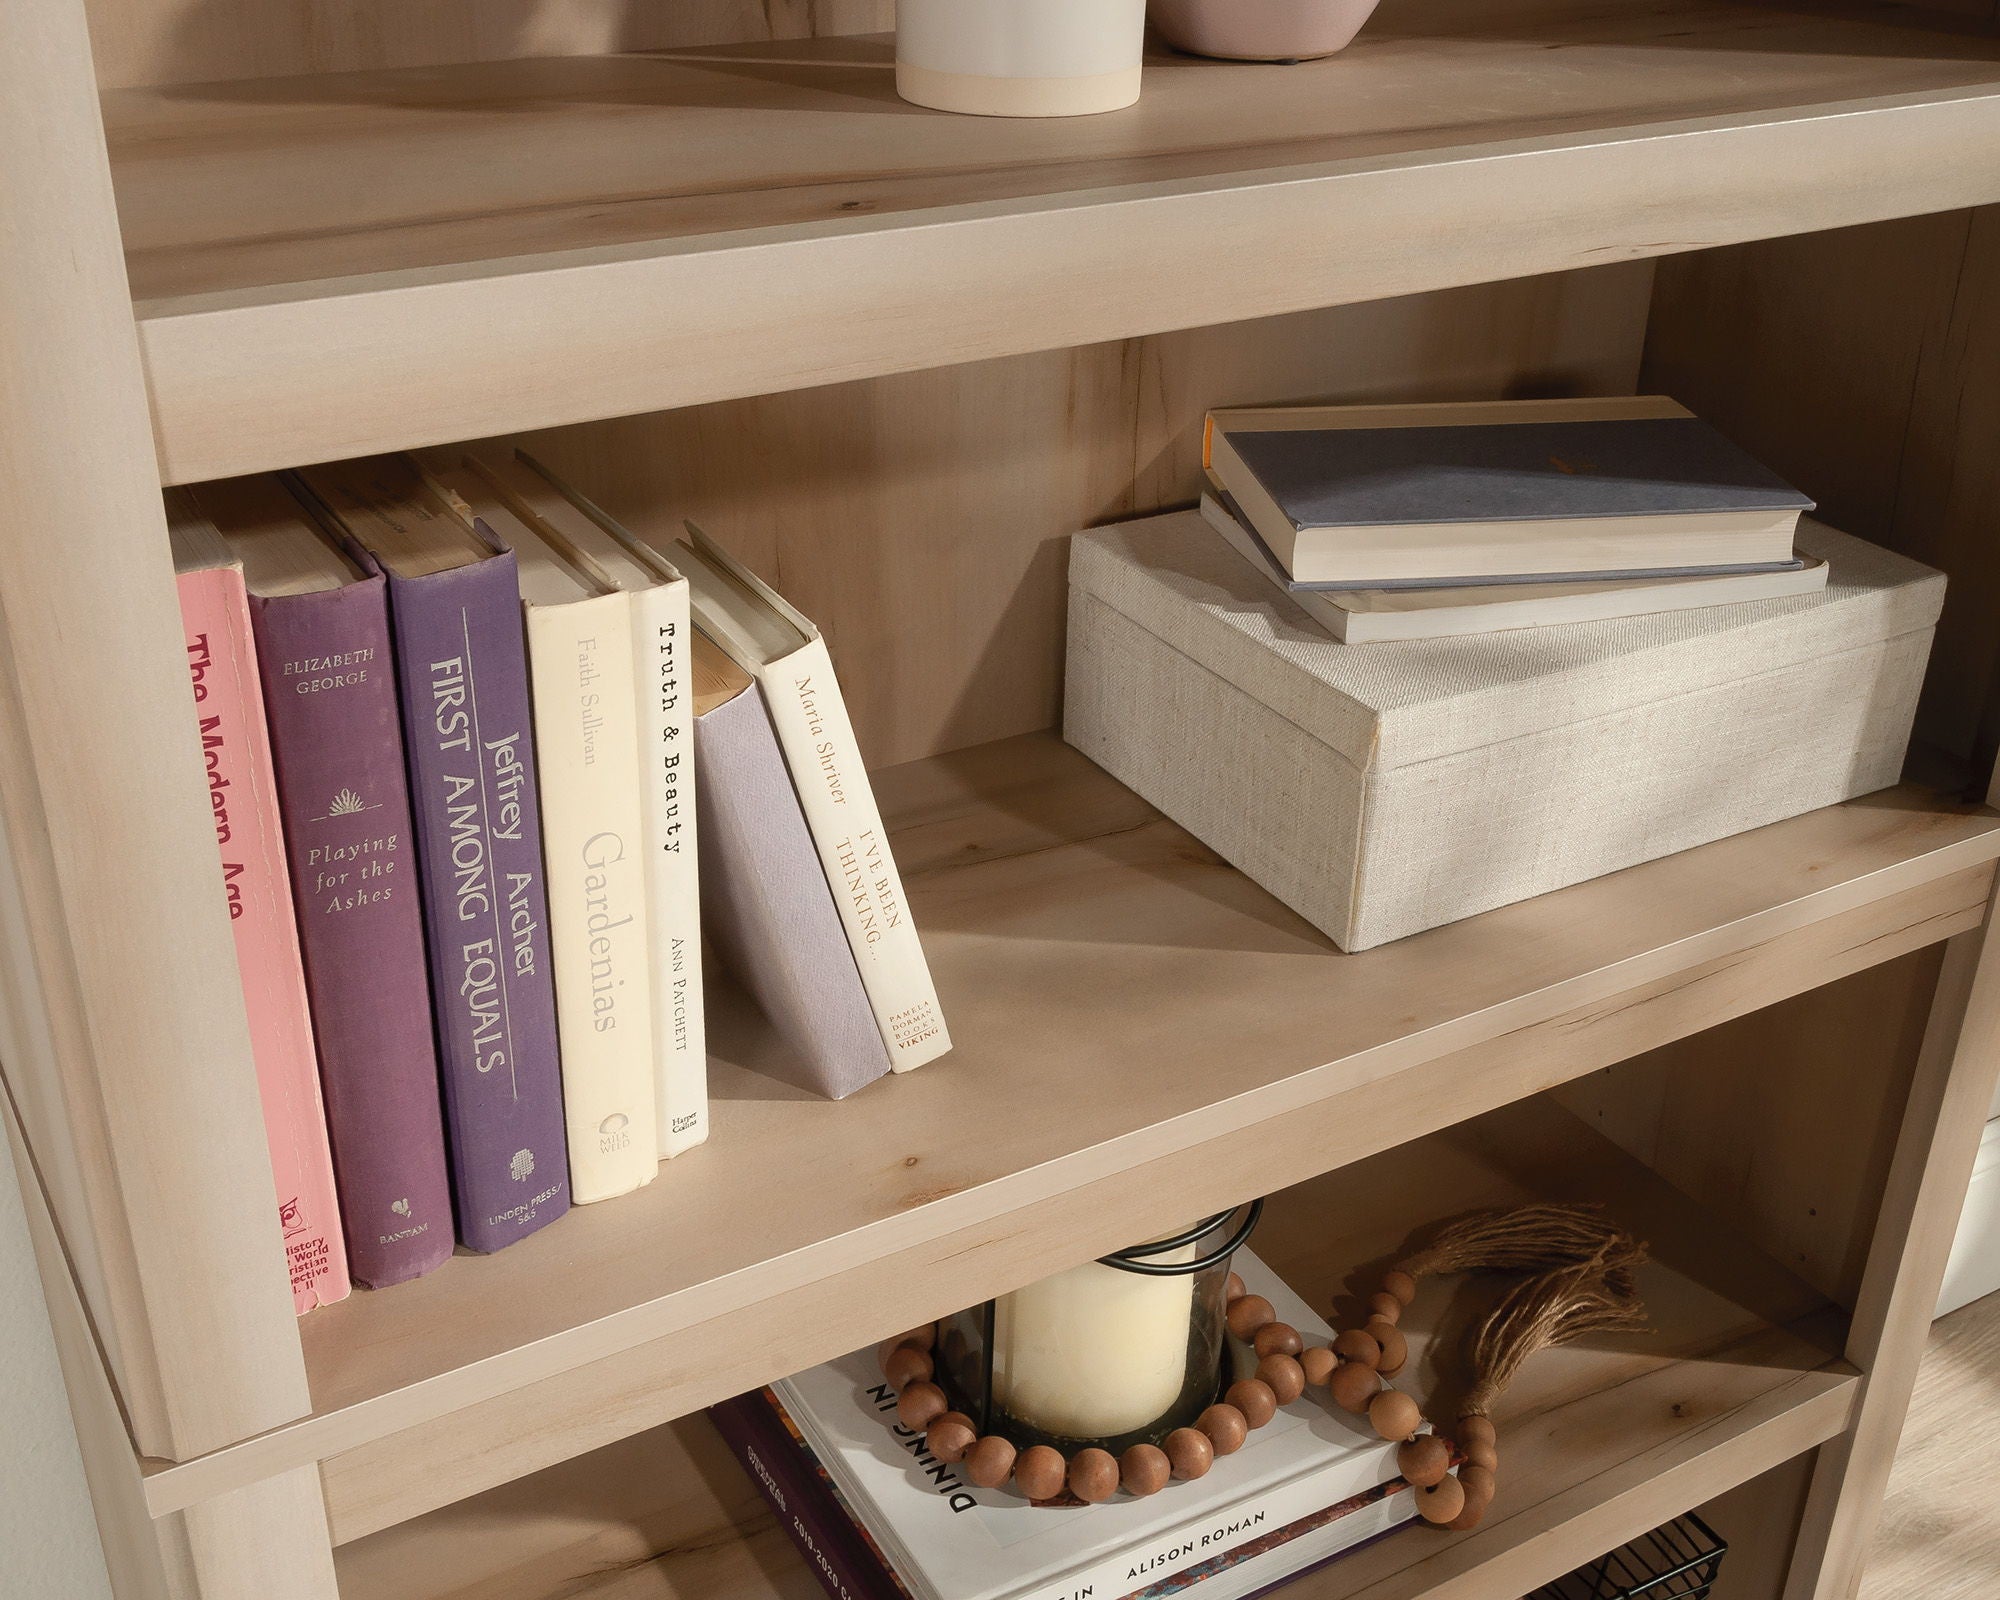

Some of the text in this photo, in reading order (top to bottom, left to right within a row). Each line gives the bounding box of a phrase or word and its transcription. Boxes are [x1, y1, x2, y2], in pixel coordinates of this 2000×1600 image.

[283, 647, 375, 676] ELIZABETH
[296, 669, 368, 695] GEORGE
[578, 638, 604, 767] Faith Sullivan
[659, 623, 682, 853] Truth & Beauty
[795, 675, 846, 805] Maria Shriver
[308, 832, 399, 866] Playing
[430, 656, 506, 1073] FIRST AMONG EQUALS
[484, 732, 538, 977] Jeffrey Archer
[315, 859, 395, 894] for the
[859, 829, 902, 929] I'VE BEEN
[326, 886, 393, 914] Ashes
[582, 831, 634, 1033] Gardenias
[671, 938, 687, 1051] ANN PATCHETT
[889, 1001, 929, 1023] PAMELA
[892, 1008, 932, 1032] DORMAN
[895, 1017, 935, 1040] BOOKS
[899, 1027, 939, 1049] VIKING
[489, 1203, 529, 1226] LINDEN
[518, 1208, 537, 1225] S&S
[379, 1223, 429, 1245] BANTAM
[295, 1244, 329, 1262] World
[866, 1384, 898, 1412] IN
[794, 1515, 838, 1588] 2019-2020
[1126, 1510, 1265, 1580] ALISON ROMAN
